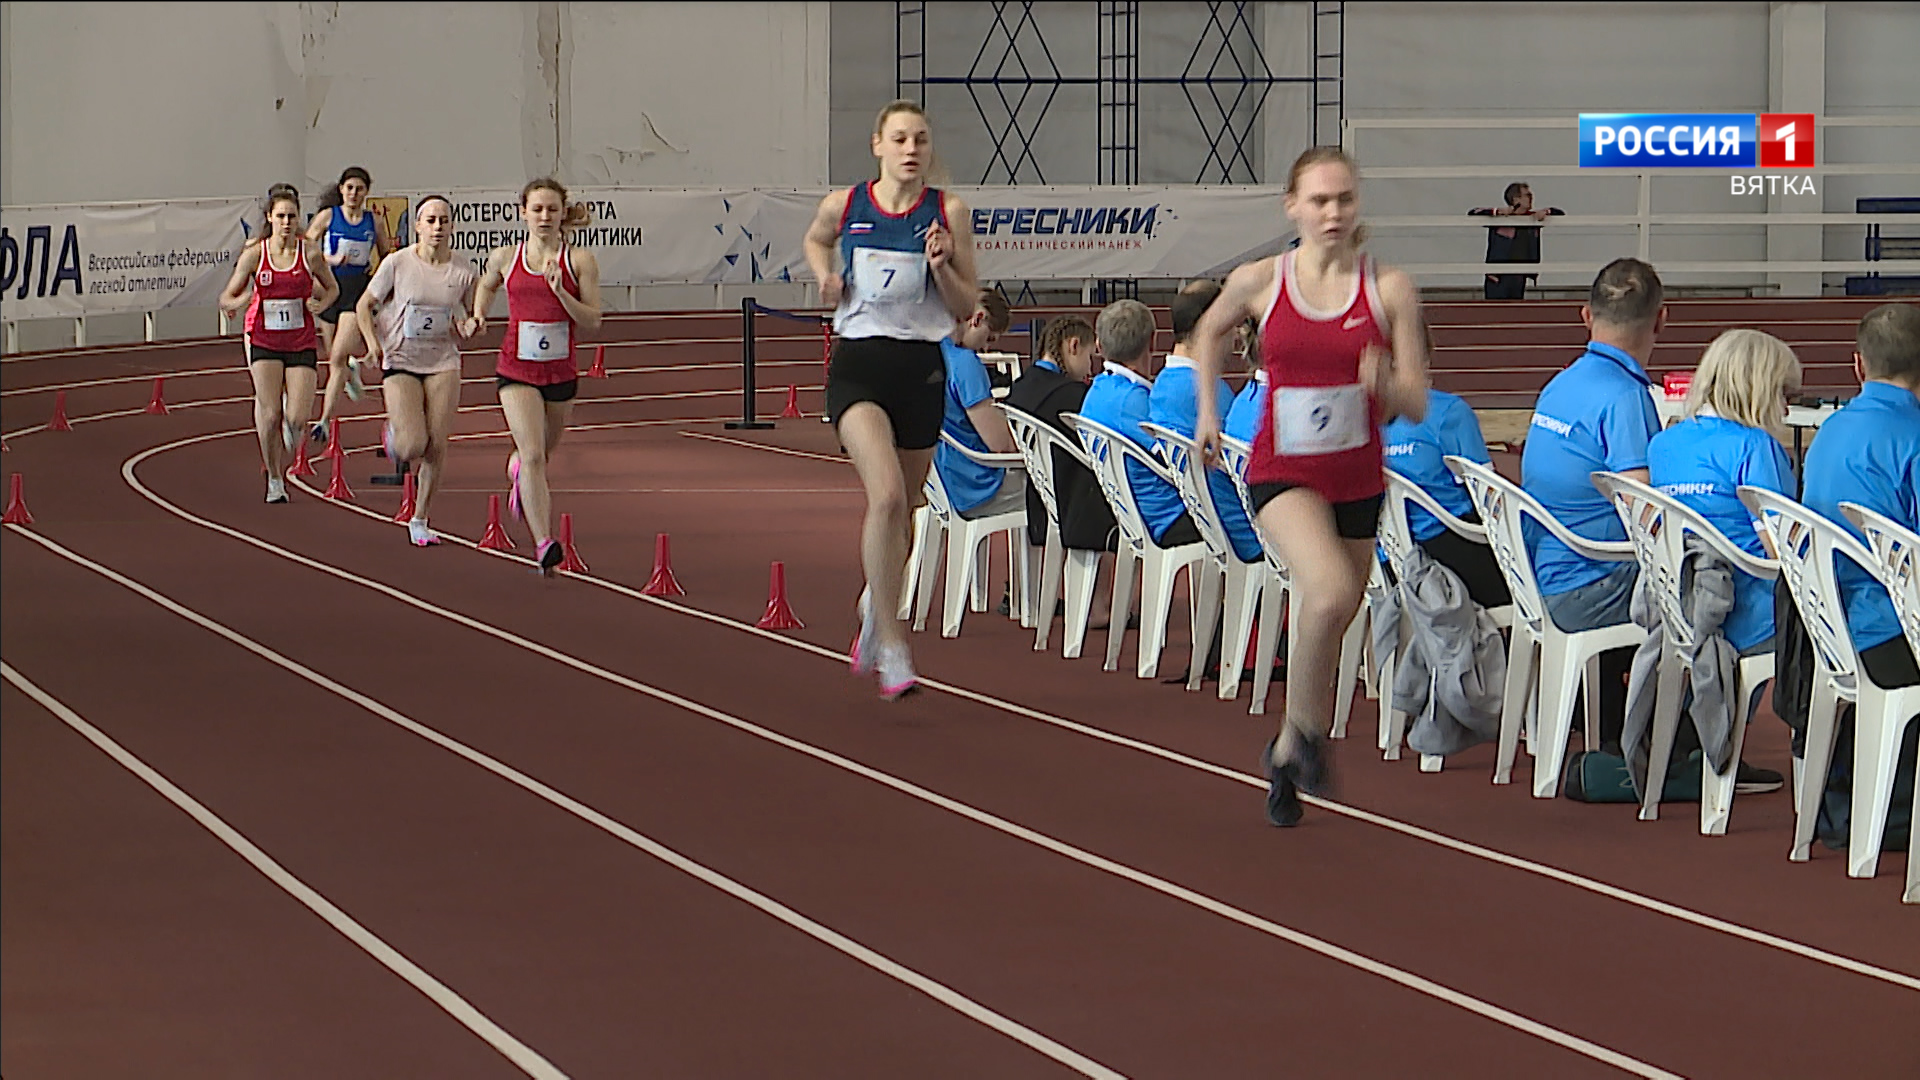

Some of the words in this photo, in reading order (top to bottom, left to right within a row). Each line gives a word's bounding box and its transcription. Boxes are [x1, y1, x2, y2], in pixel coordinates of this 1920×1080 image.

[971, 204, 1158, 238] ЕРЕСНИКИ
[976, 240, 1094, 250] КОАТЛЕТИЧЕСКИЙ
[88, 251, 165, 274] Всероссийская
[167, 247, 230, 270] федерация
[89, 275, 126, 295] легкой
[128, 275, 187, 293] атлетики
[881, 269, 896, 289] 7
[279, 310, 290, 321] 11
[423, 317, 433, 330] 2
[539, 335, 550, 350] 6
